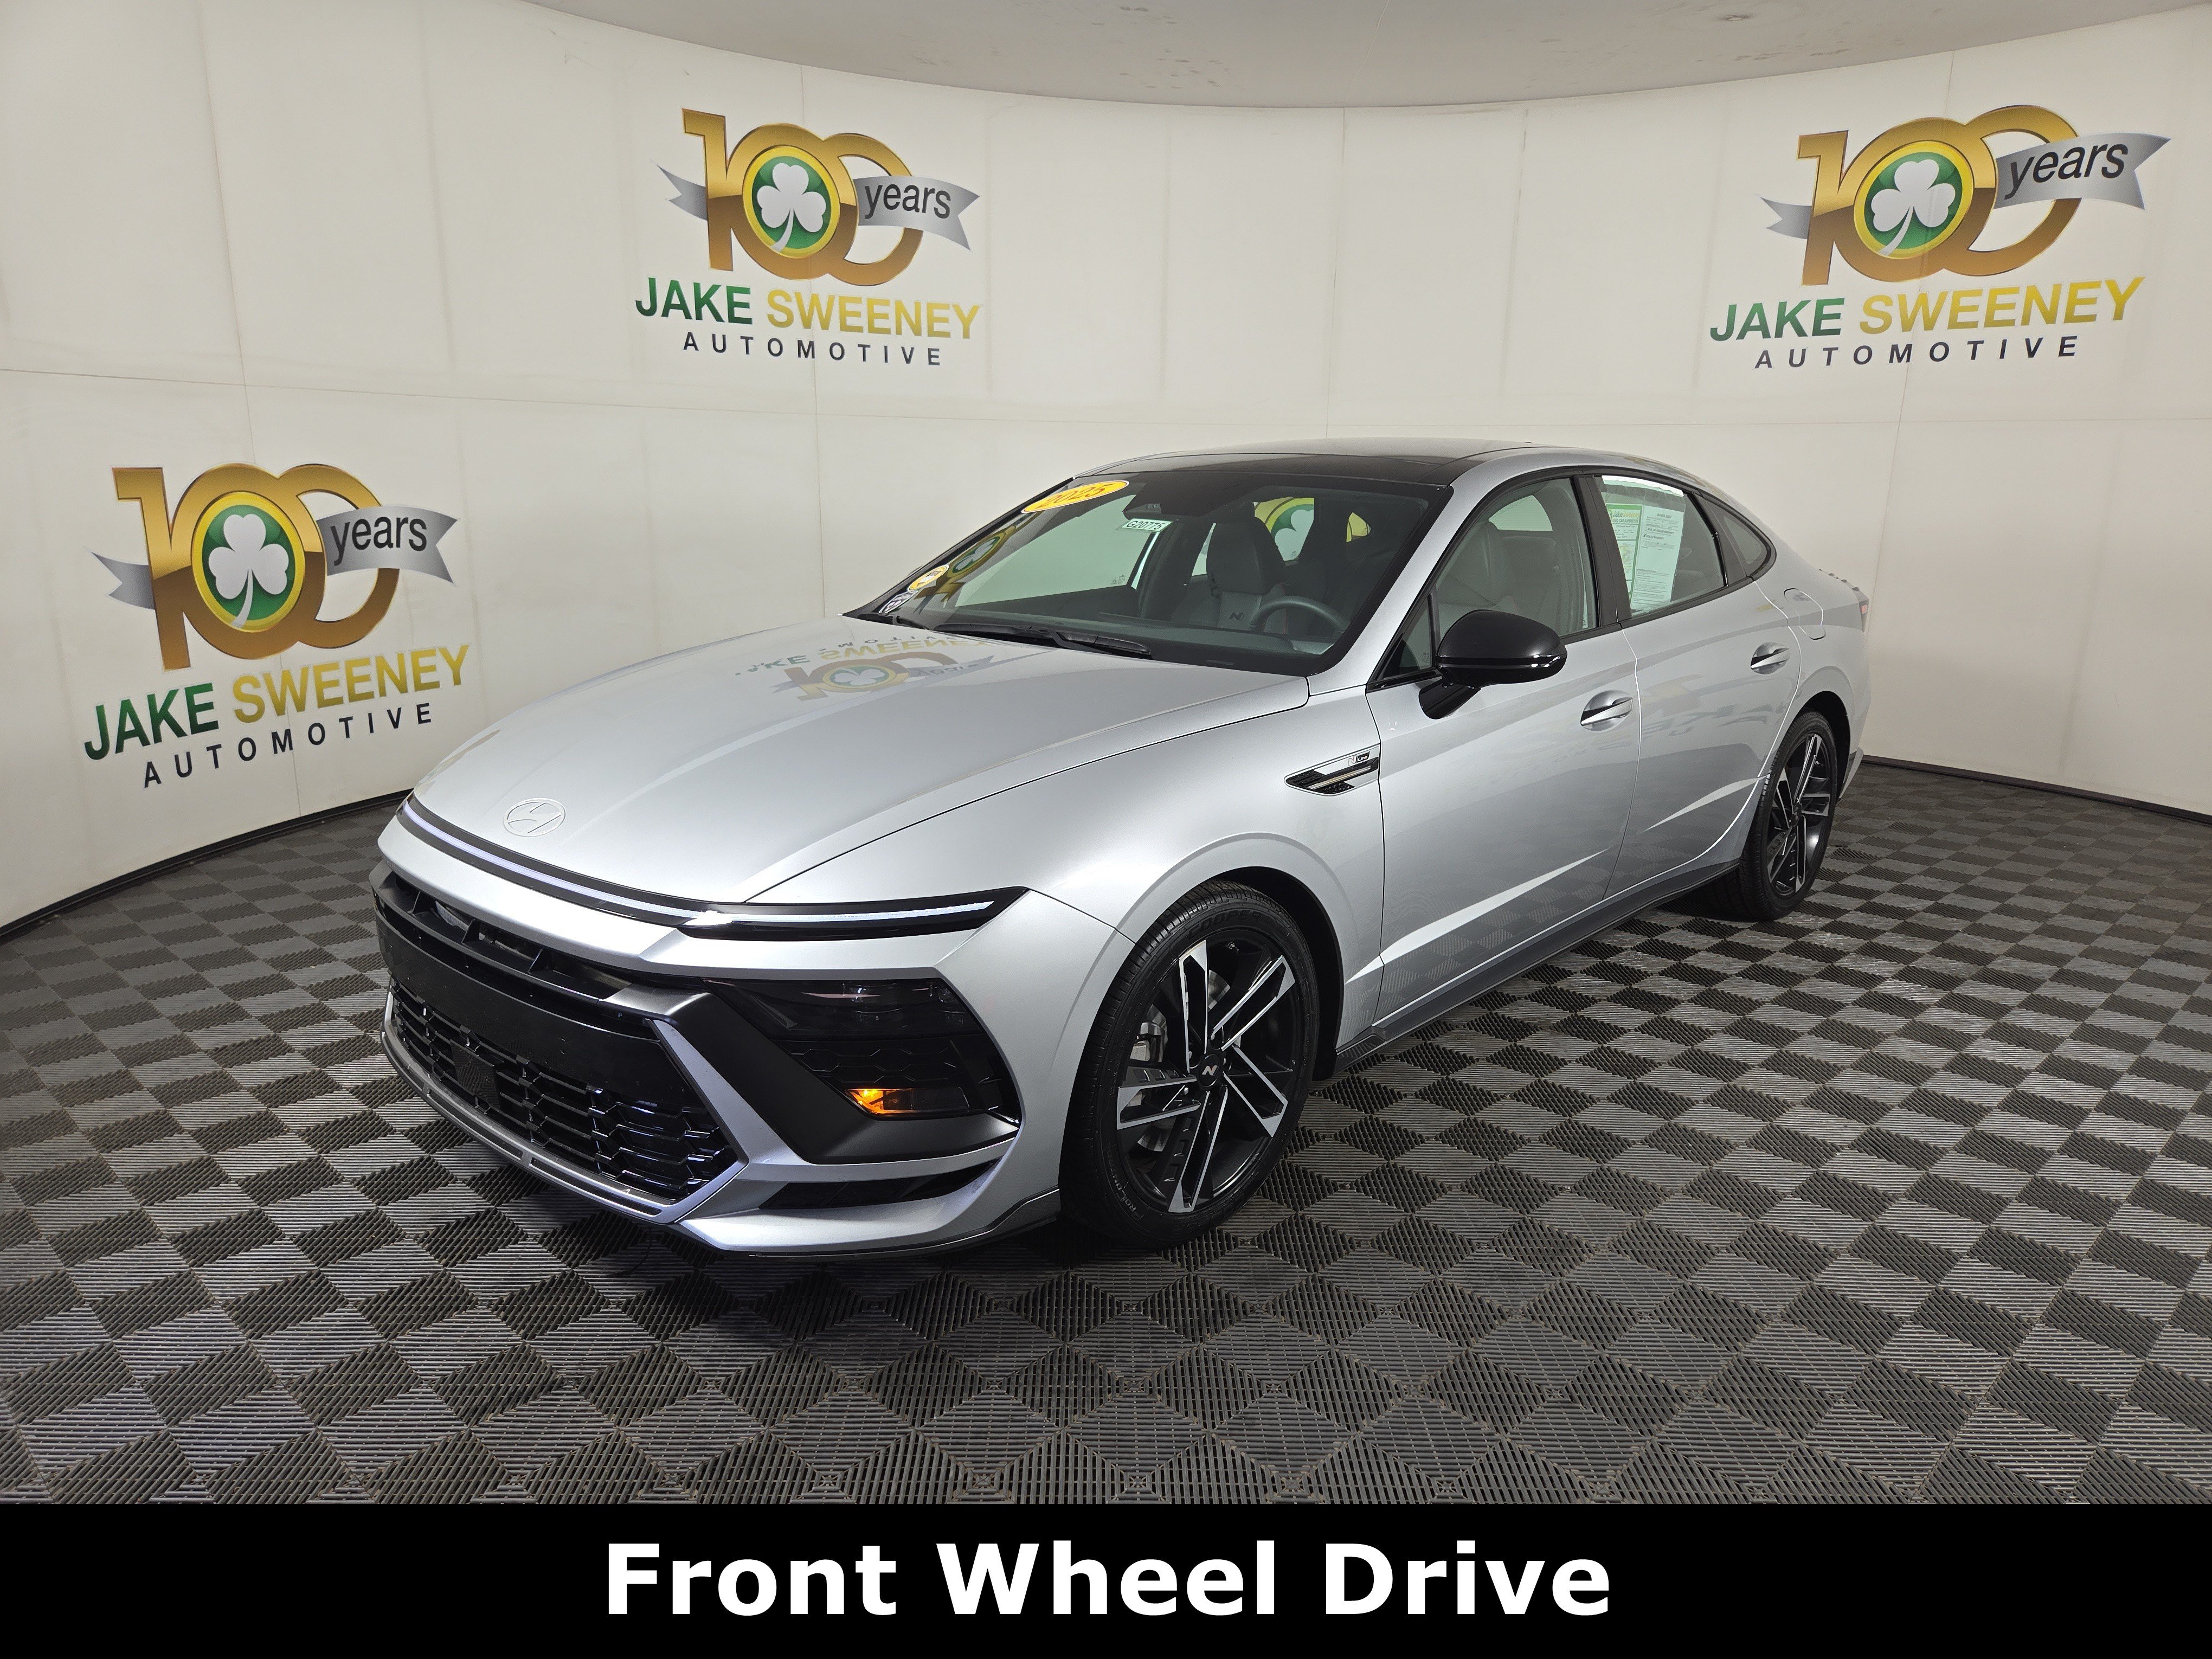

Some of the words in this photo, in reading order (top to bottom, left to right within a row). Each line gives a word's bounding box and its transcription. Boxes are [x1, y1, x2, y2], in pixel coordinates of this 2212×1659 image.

[681, 107, 923, 286] 100
[864, 183, 951, 219] years
[1797, 105, 2081, 286] 100
[2004, 142, 2129, 200] years
[635, 276, 753, 325] JAKE
[767, 289, 981, 339] SWEENEY
[1710, 297, 1845, 342] JAKE
[1859, 276, 2145, 335] SWEENEY
[683, 331, 941, 366] AUTOMOTIVE
[1754, 335, 2078, 369] AUTOMOTIVE
[1034, 483, 1115, 510] 2025
[1126, 520, 1165, 530] G20775
[112, 464, 400, 672] 100
[330, 516, 428, 567] years
[84, 682, 219, 760] JAKE
[232, 645, 470, 723] SWEENEY
[143, 702, 432, 789] AUTOMOTIVE
